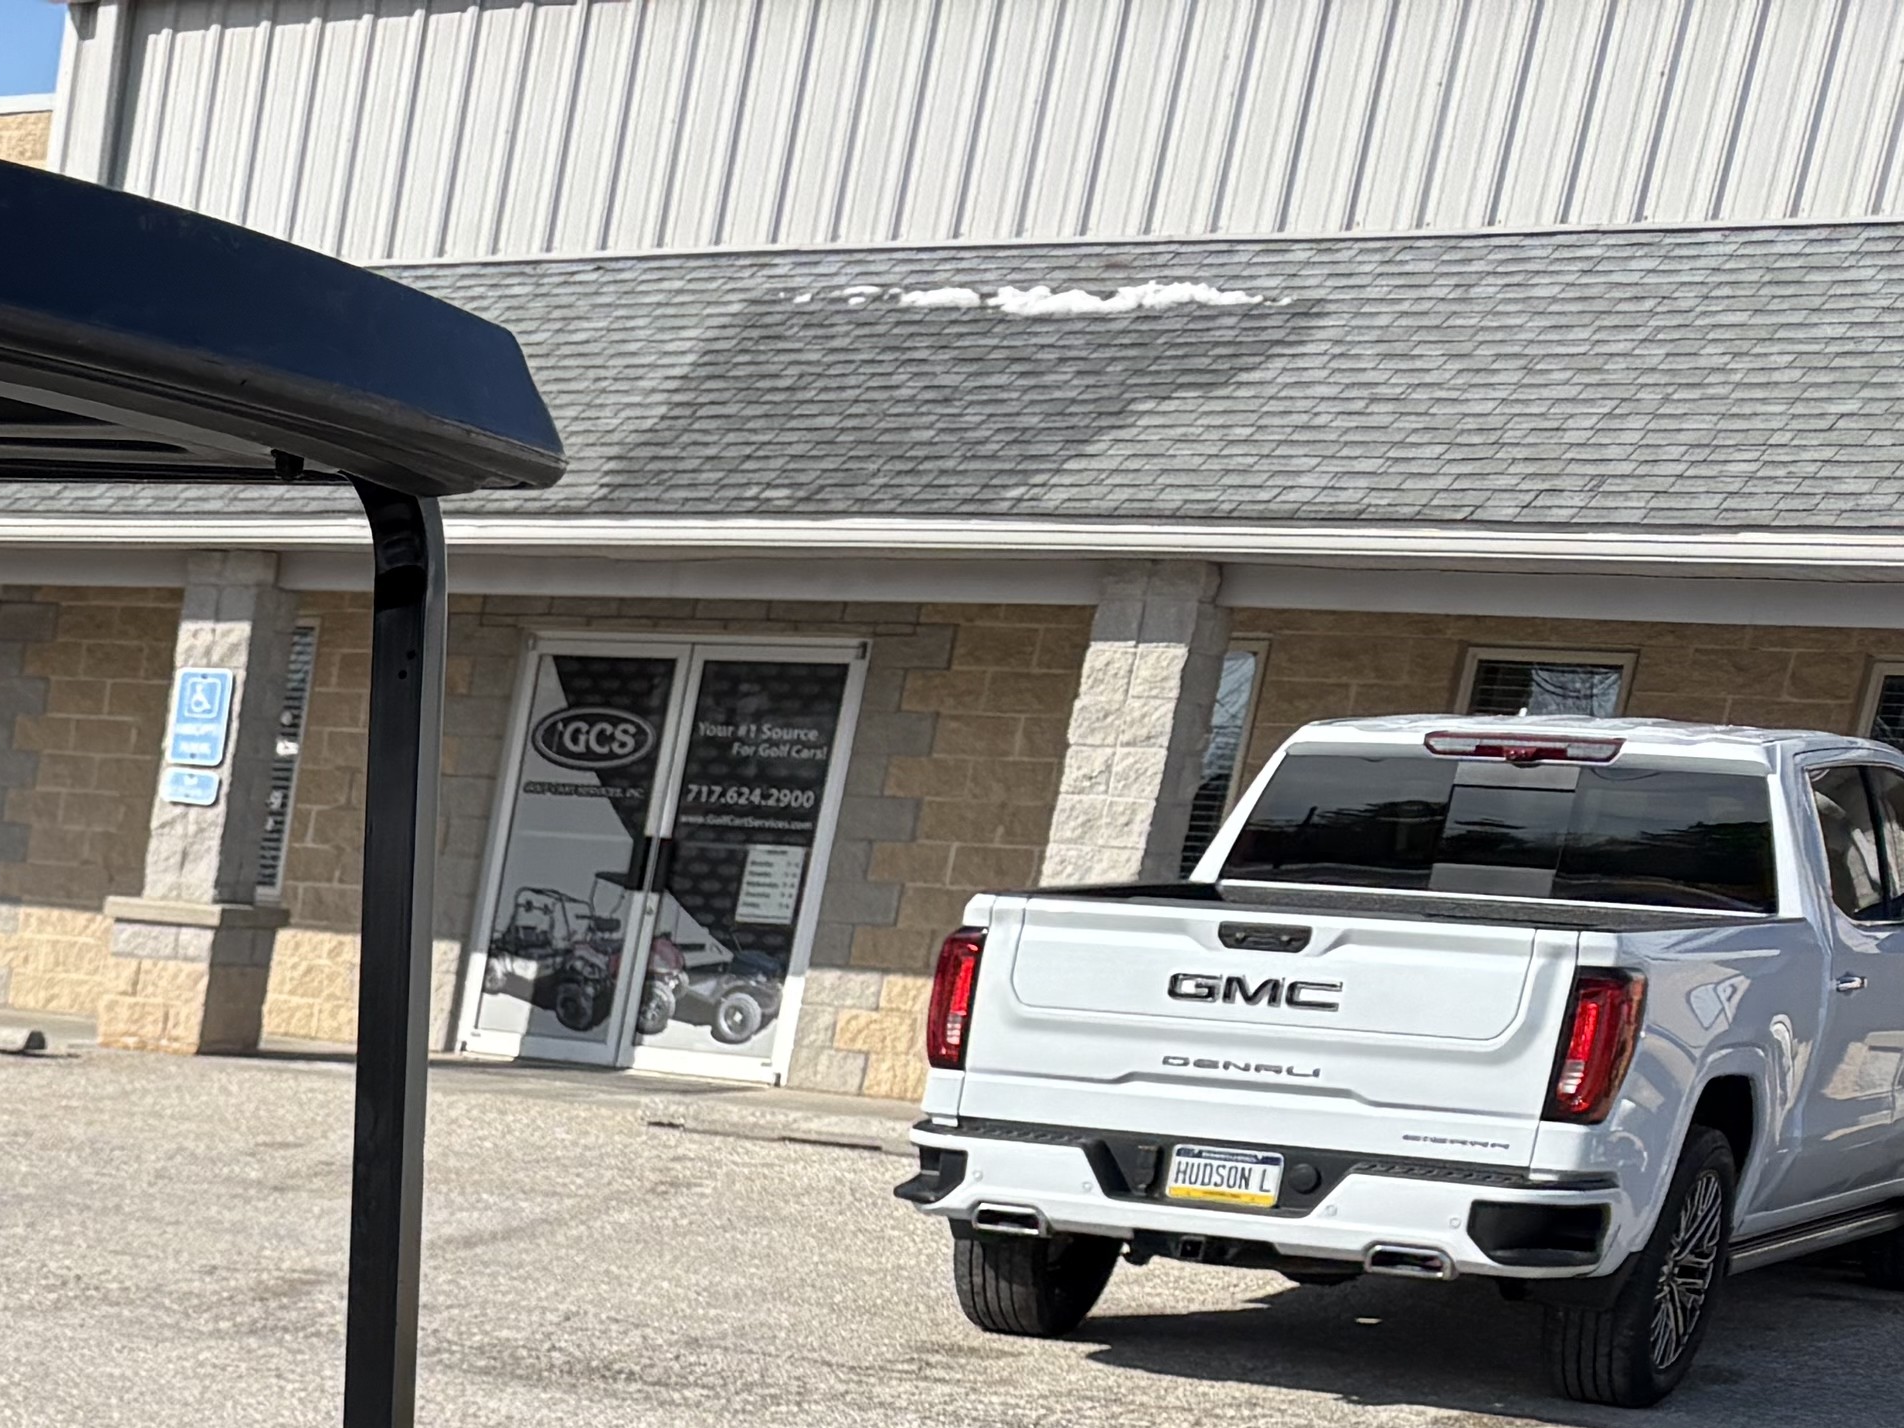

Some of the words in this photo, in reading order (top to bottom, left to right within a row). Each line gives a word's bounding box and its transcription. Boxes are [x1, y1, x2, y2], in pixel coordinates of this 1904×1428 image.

[563, 721, 637, 755] GCS
[698, 721, 735, 737] Your
[737, 724, 757, 739] #1
[761, 724, 819, 741] Source
[732, 742, 756, 756] For
[758, 743, 790, 758] Golf
[792, 745, 828, 760] Cars!
[686, 784, 815, 808] 717.624.2900
[1167, 973, 1343, 1012] GMC
[1162, 1055, 1321, 1078] DENALI
[1173, 1160, 1252, 1190] HUDSON
[1259, 1168, 1271, 1193] L
